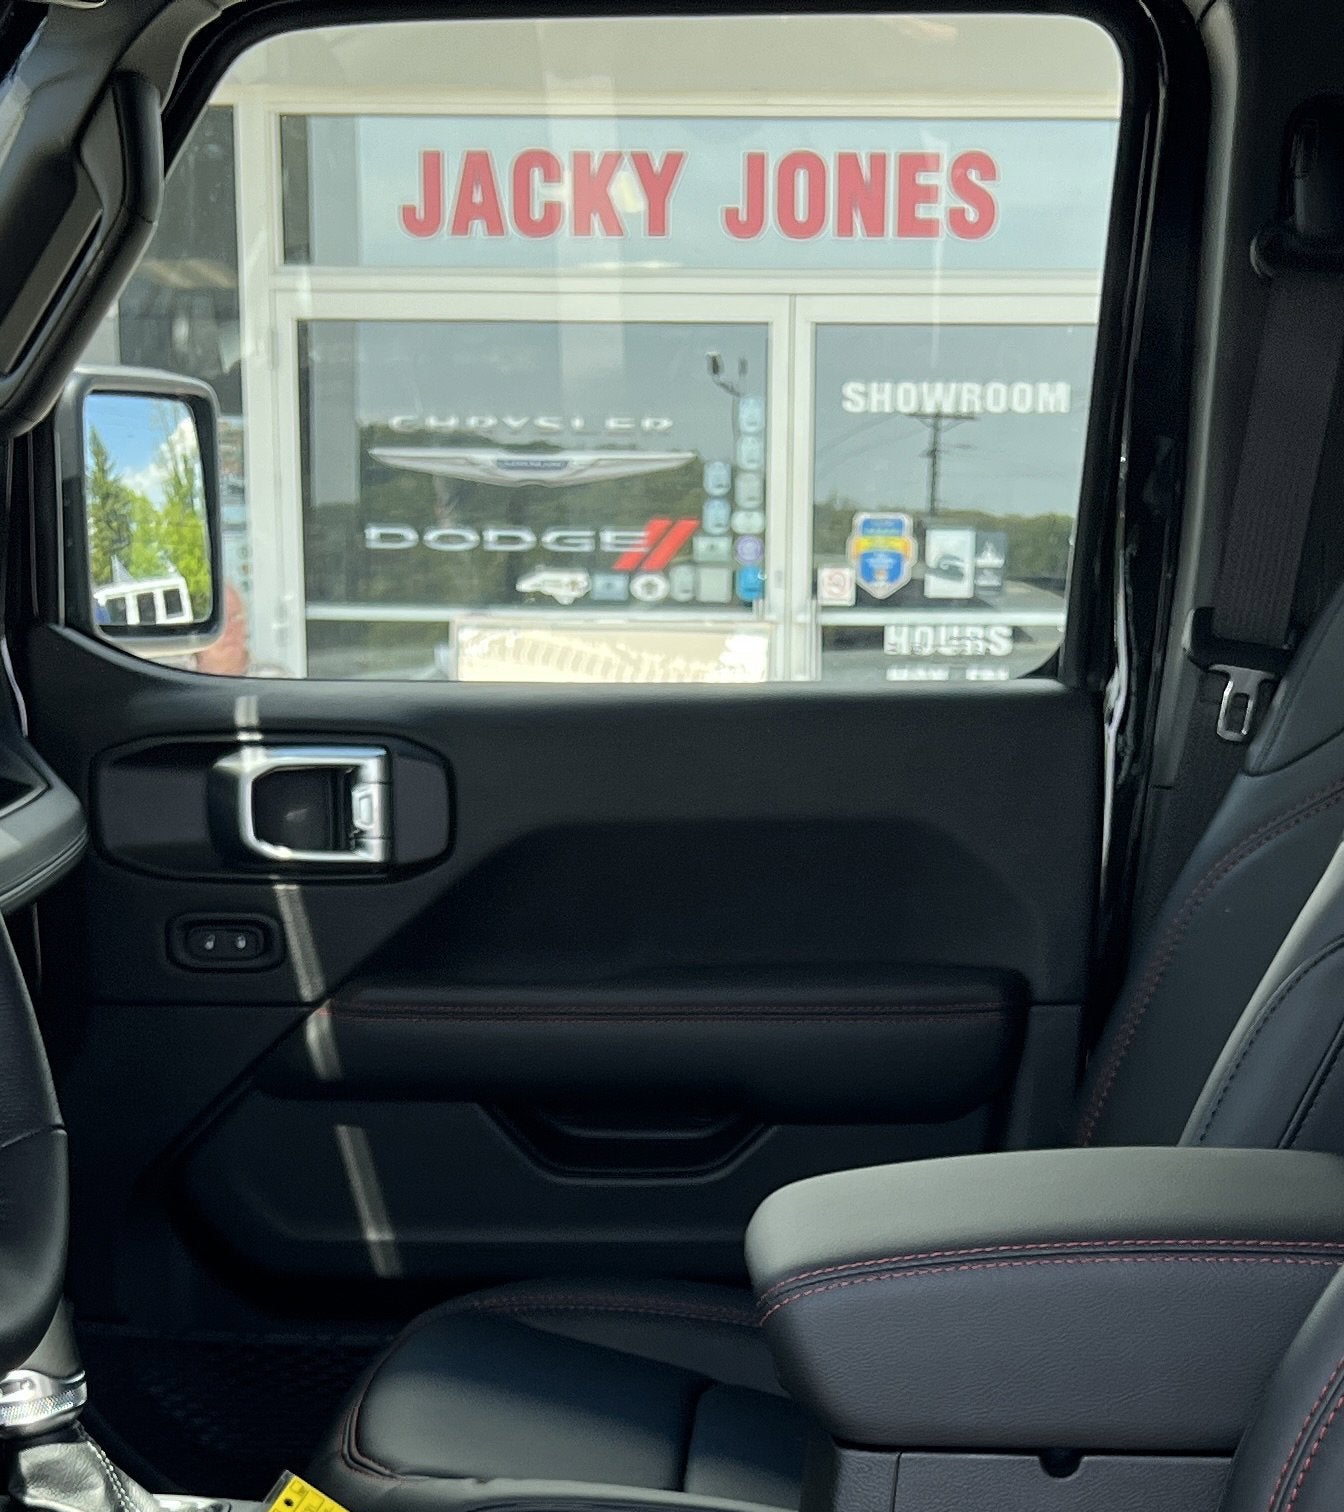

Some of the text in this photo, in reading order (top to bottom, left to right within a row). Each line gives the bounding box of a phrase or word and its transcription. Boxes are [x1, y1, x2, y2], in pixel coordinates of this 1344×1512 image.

[399, 149, 1000, 239] JACKY JONES
[841, 381, 1071, 413] SHOWROOM
[364, 523, 650, 552] DODGE
